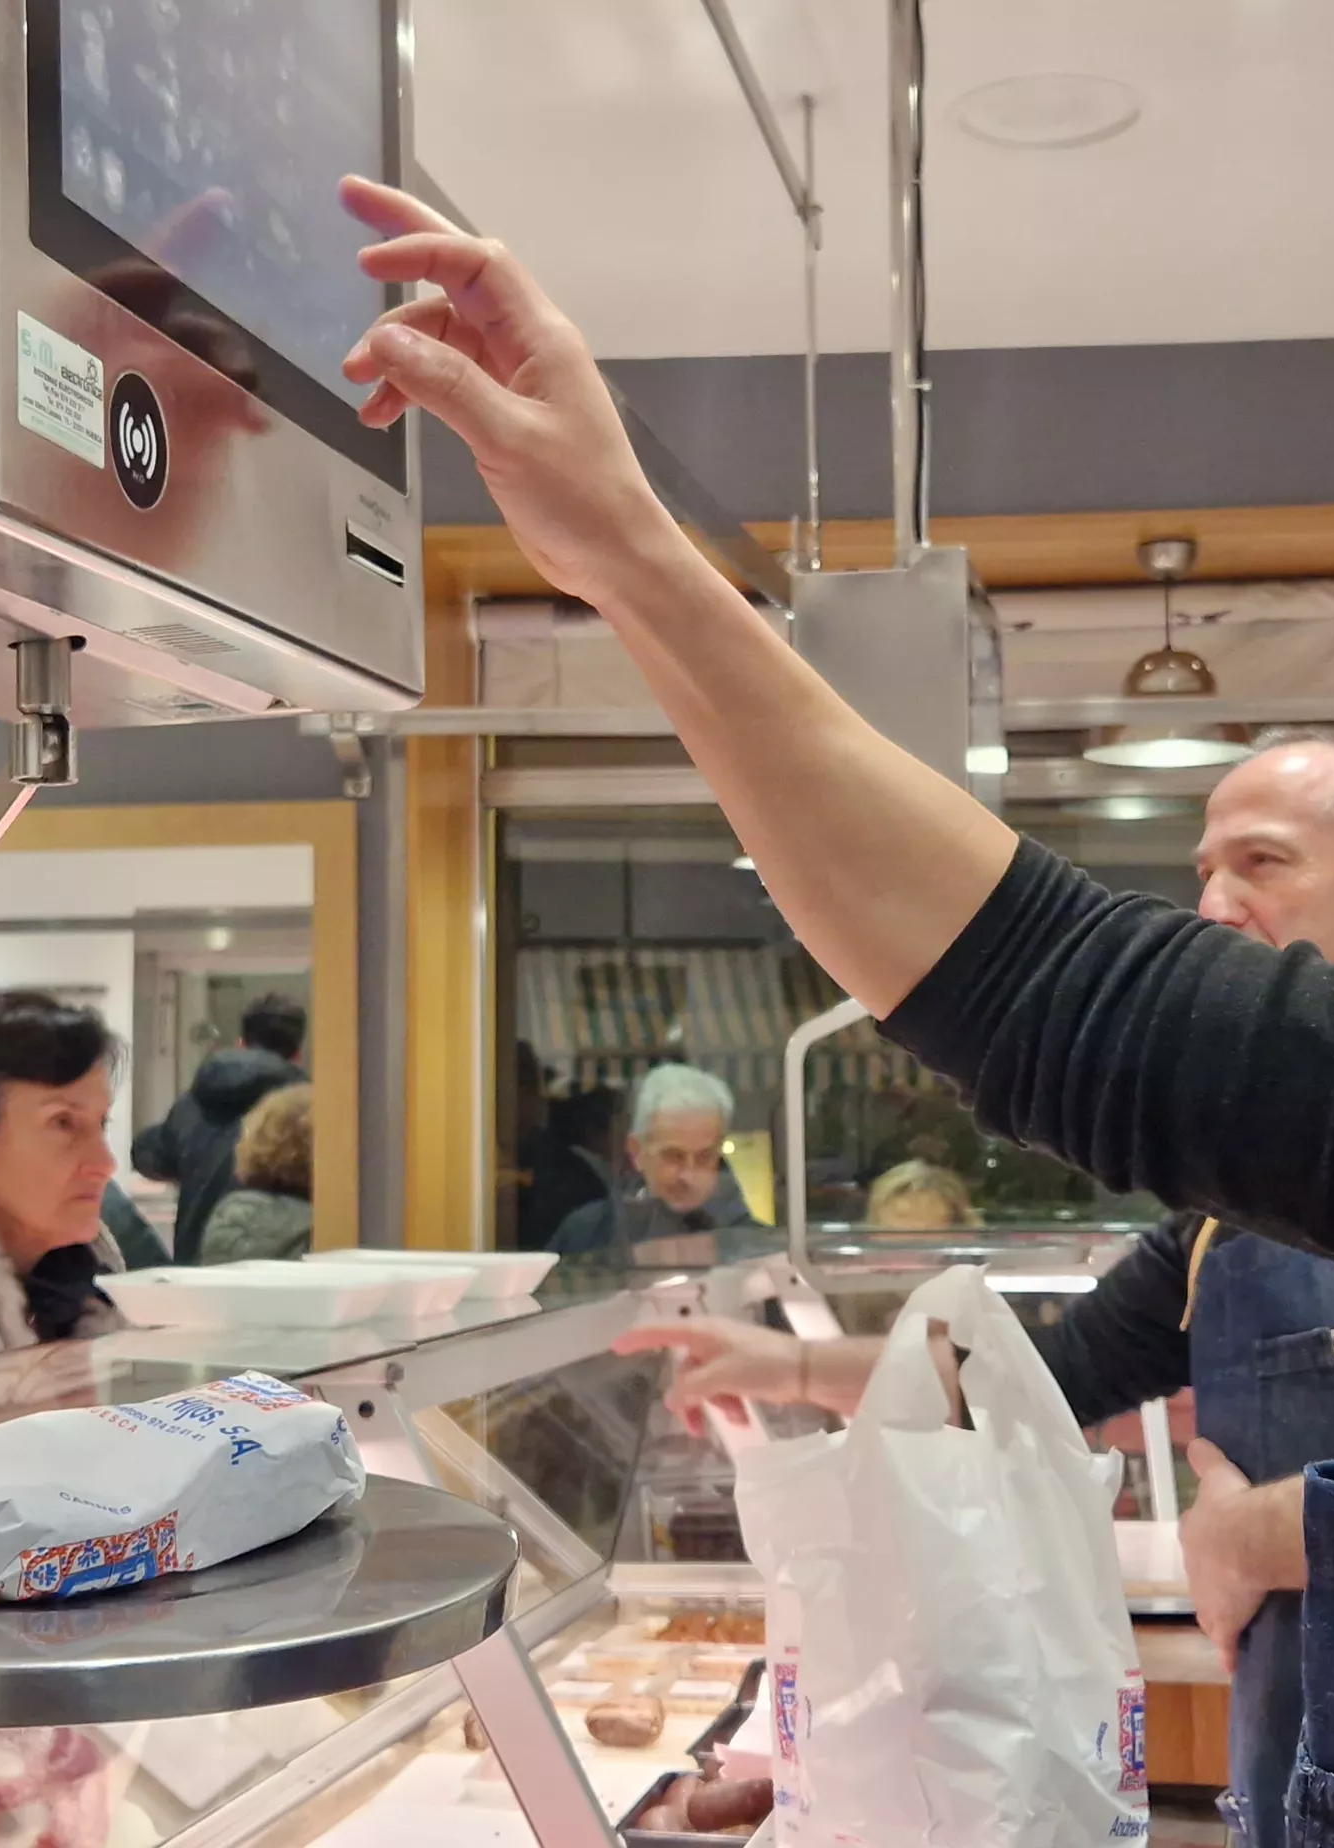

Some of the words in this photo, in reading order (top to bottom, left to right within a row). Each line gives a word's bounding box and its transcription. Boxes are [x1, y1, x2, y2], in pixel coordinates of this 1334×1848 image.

[90, 1407, 138, 1434] UESCA
[147, 1417, 167, 1430] 974
[219, 1425, 264, 1465] S.A.
